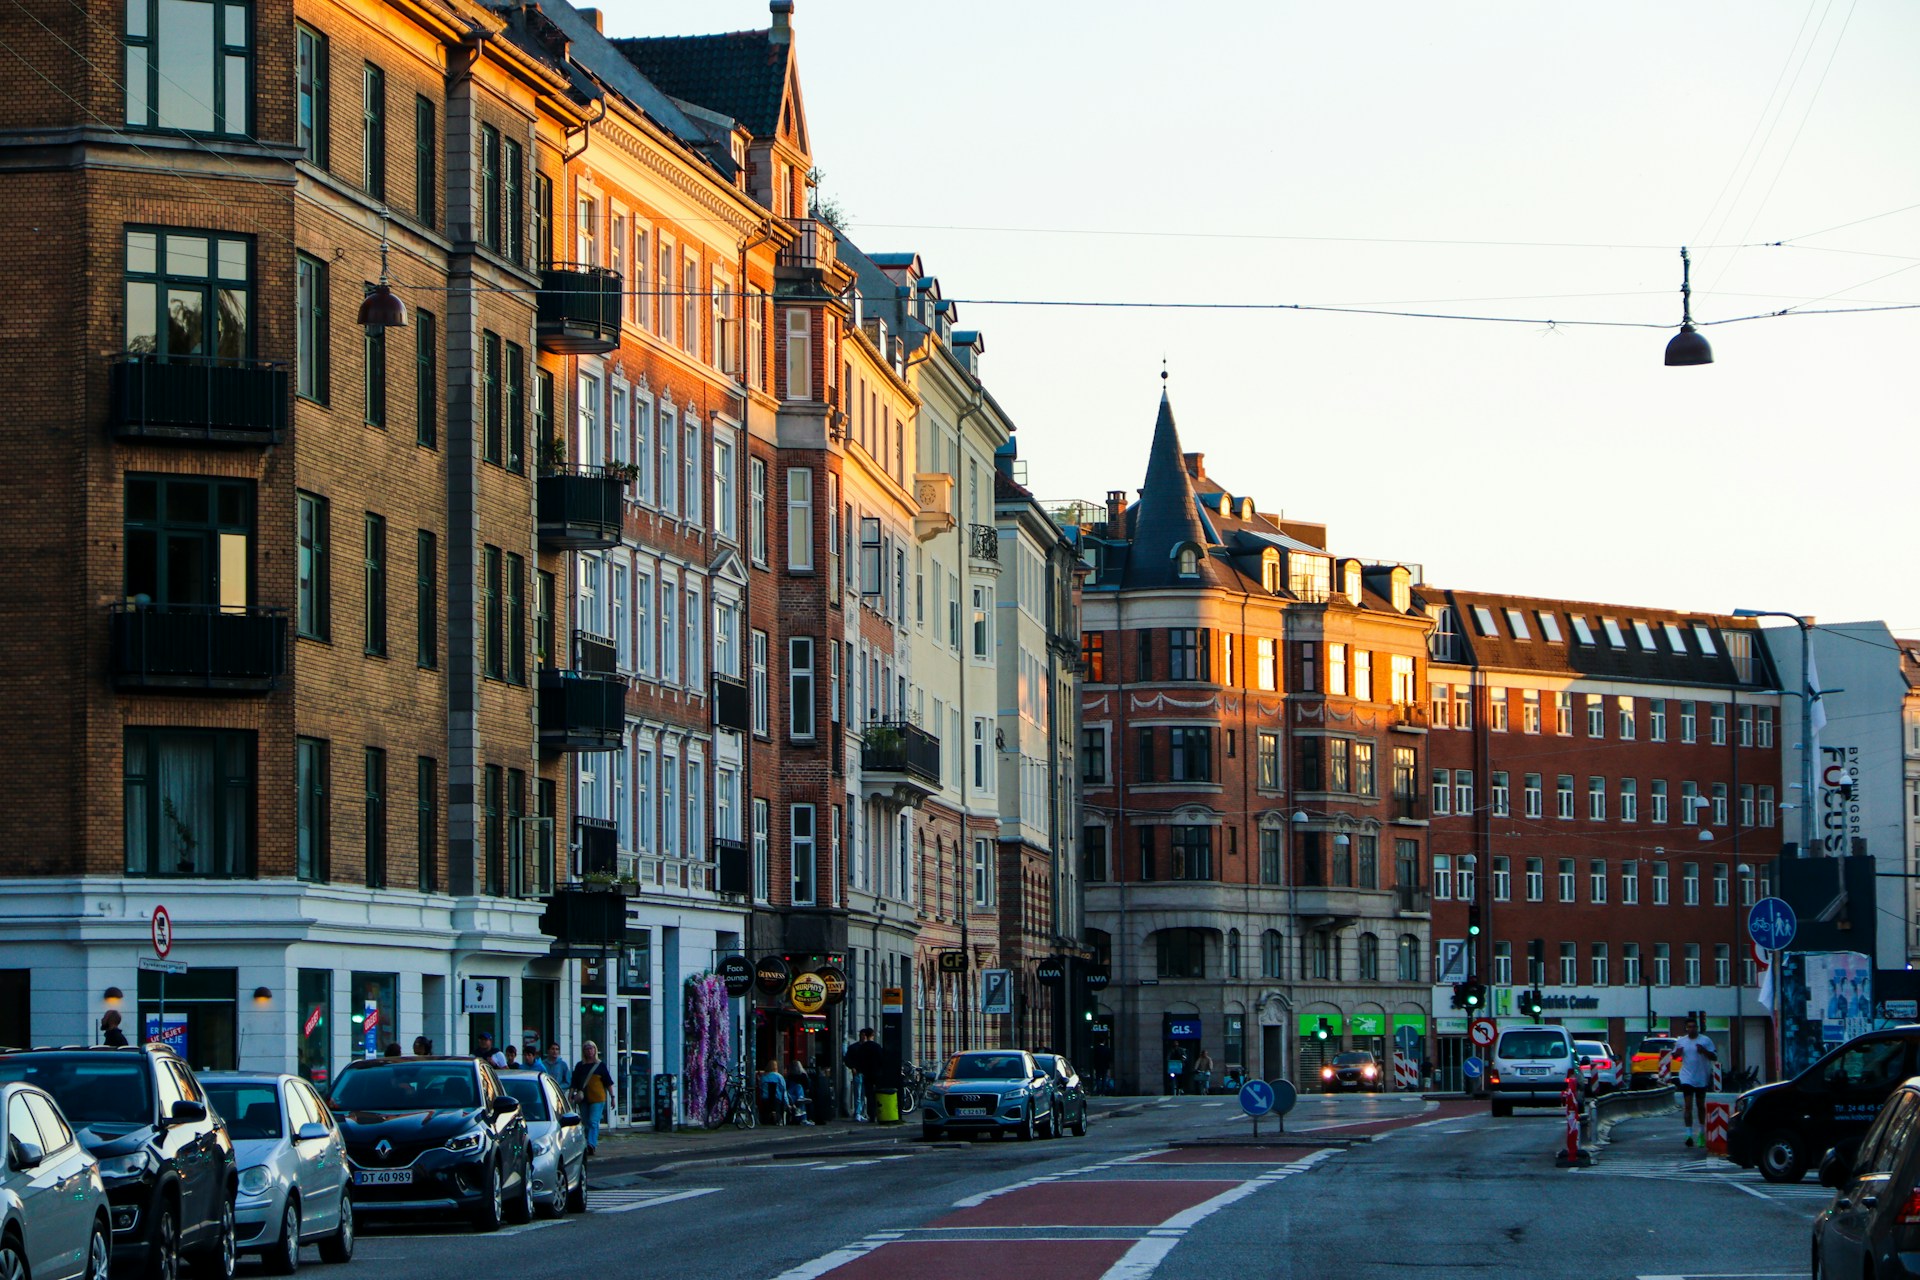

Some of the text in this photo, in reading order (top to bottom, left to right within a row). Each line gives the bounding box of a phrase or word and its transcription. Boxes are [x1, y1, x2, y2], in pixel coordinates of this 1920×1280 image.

[1824, 747, 1845, 852] FOCUS
[1448, 945, 1458, 961] P
[943, 954, 964, 968] GF
[724, 975, 749, 983] Lounge
[757, 970, 785, 979] GUINNESS
[990, 975, 1001, 991] P
[362, 1172, 411, 1183] DT 40 989
